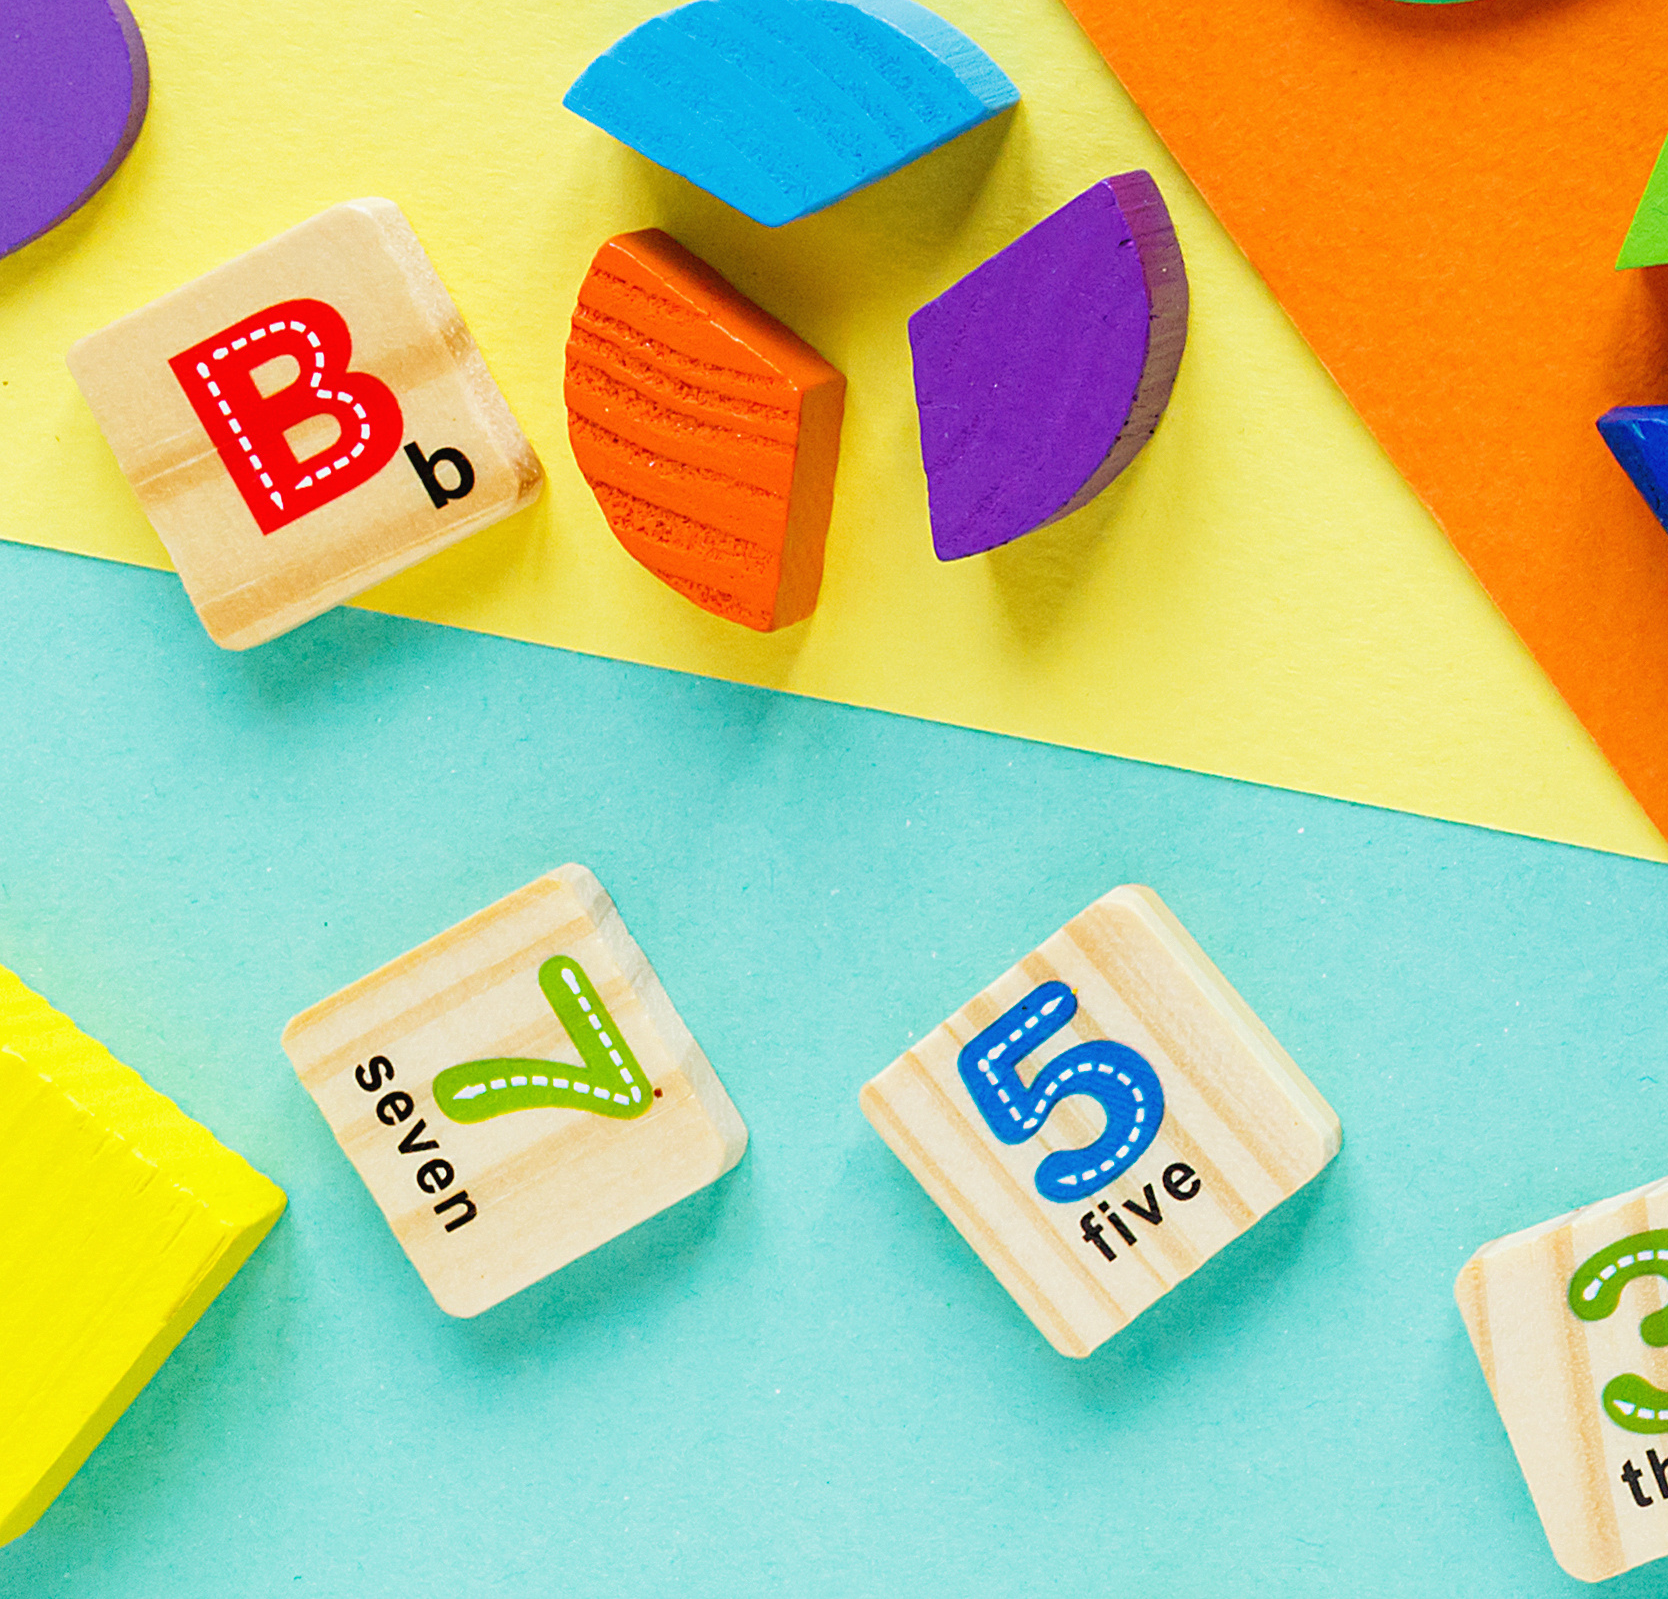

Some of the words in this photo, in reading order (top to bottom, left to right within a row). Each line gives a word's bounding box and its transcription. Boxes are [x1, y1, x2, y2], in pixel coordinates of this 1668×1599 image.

[169, 300, 403, 534] B
[404, 443, 474, 508] b
[432, 955, 653, 1123] 7
[958, 981, 1164, 1203] 5
[356, 1057, 476, 1232] seven
[1081, 1163, 1200, 1261] five
